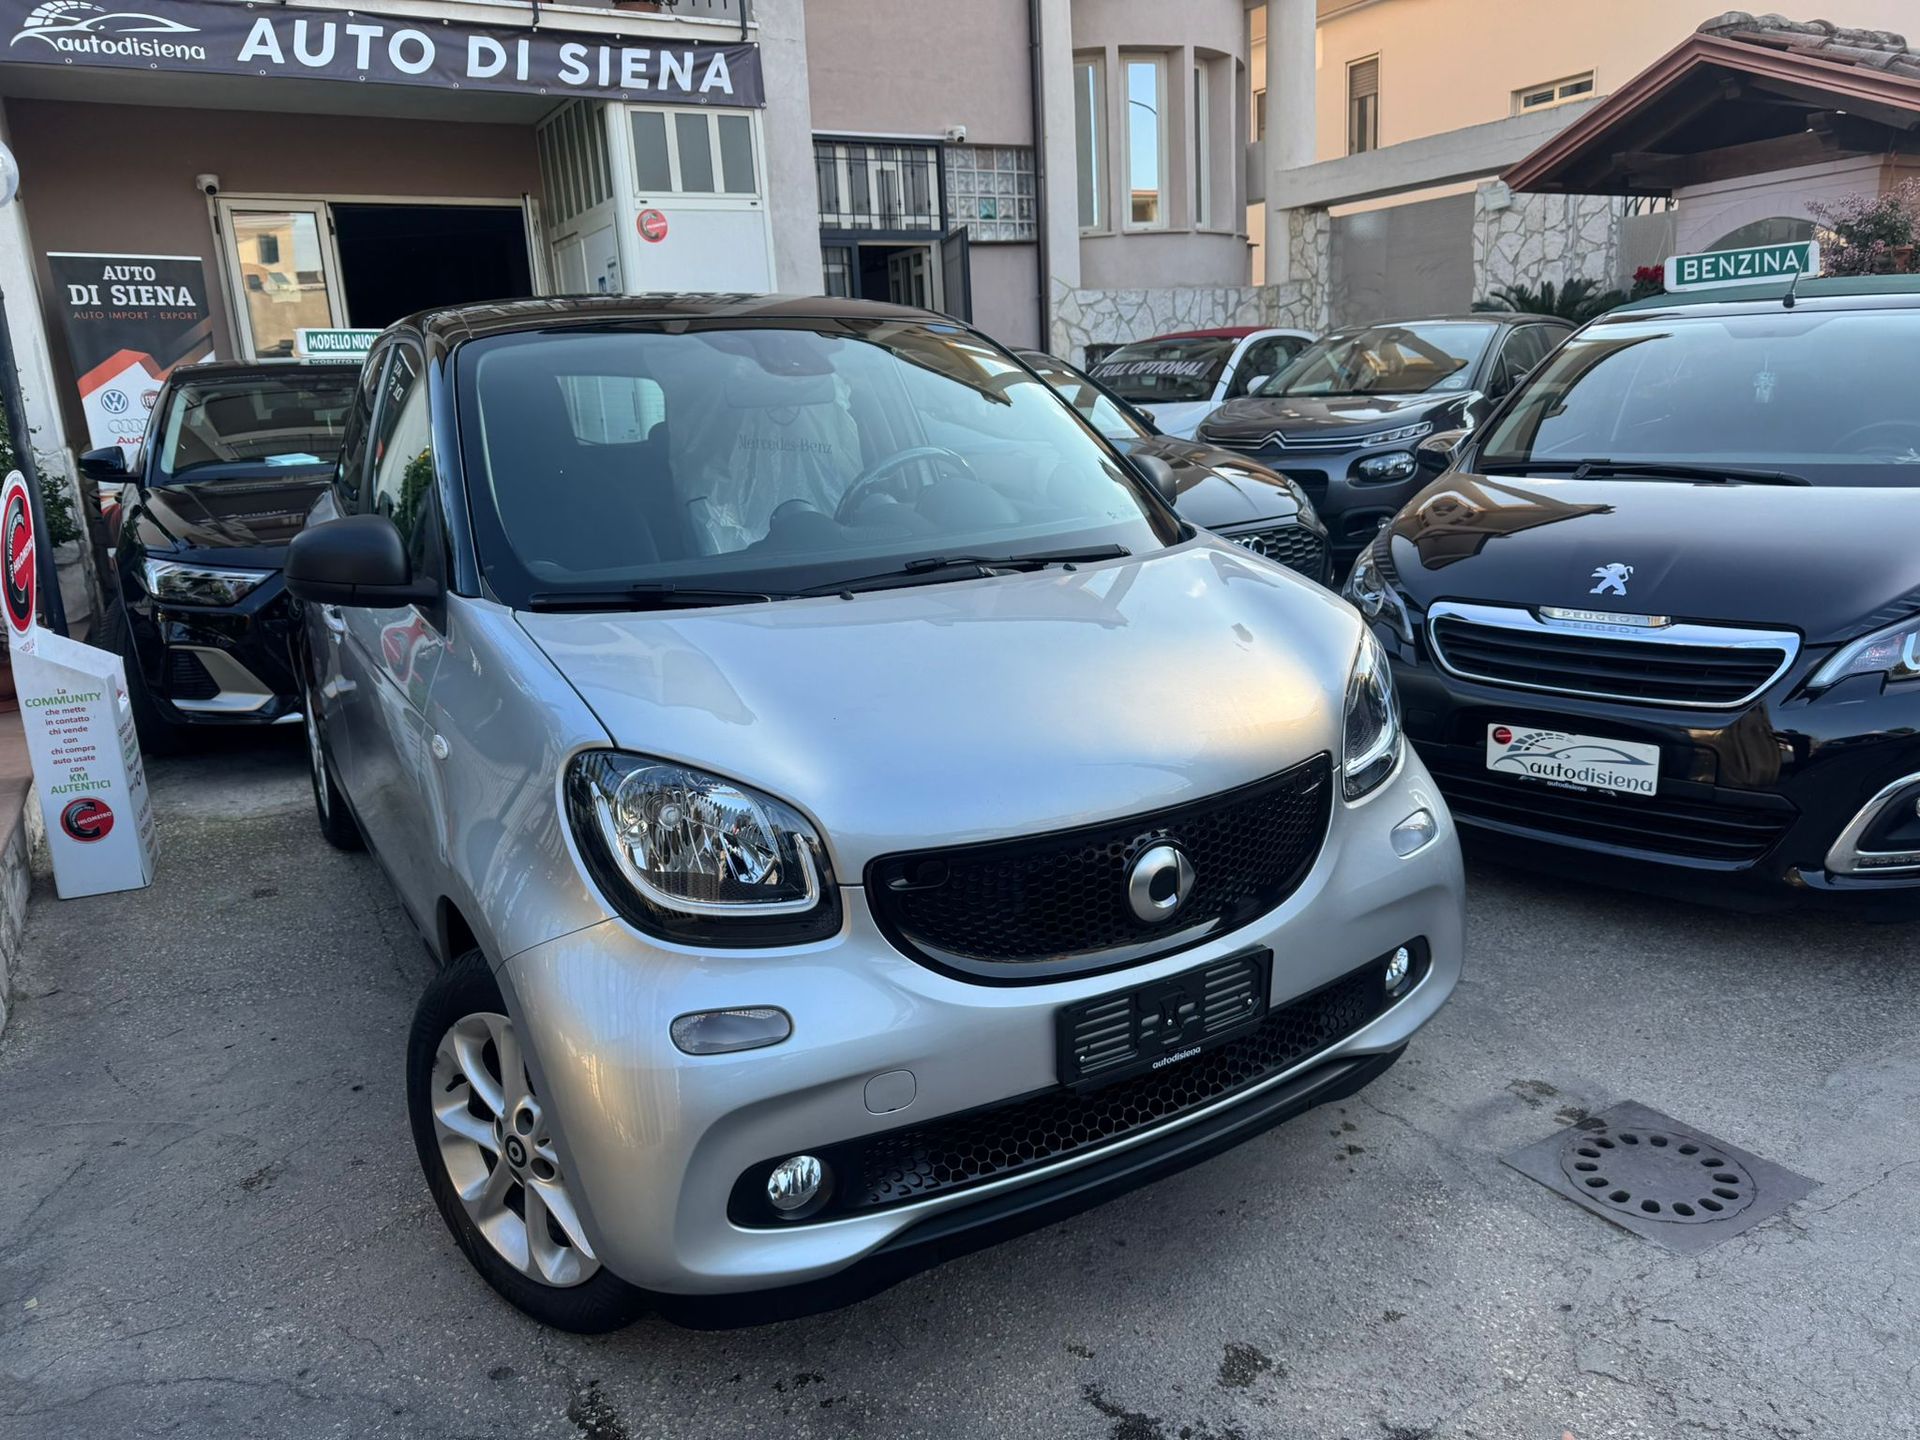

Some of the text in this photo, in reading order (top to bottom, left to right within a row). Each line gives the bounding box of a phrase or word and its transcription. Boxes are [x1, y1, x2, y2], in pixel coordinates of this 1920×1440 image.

[57, 34, 206, 61] autodisiena
[237, 17, 734, 95] AUTO DI SIENA
[102, 265, 156, 281] AUTO
[1683, 249, 1801, 281] BENZINA
[67, 284, 197, 307] DI SIENA
[73, 311, 198, 320] AUTO IMPORT EXPORT
[308, 333, 351, 350] MODELLO
[1095, 360, 1205, 378] FULL OPTIONAL
[1561, 610, 1641, 624] PEUGEOT
[56, 687, 66, 695] La
[25, 692, 101, 708] COMMUNITY
[45, 706, 86, 716] che mette
[55, 716, 90, 725] contatto
[49, 725, 88, 736] chi vende
[51, 745, 96, 756] chi compra
[53, 755, 96, 765] auto usate
[69, 772, 88, 783] KM
[1530, 761, 1653, 792] autodisiena
[50, 779, 111, 795] AUTENTICI
[1547, 780, 1588, 792] autodisiena
[1152, 1046, 1201, 1069] autodisiena
